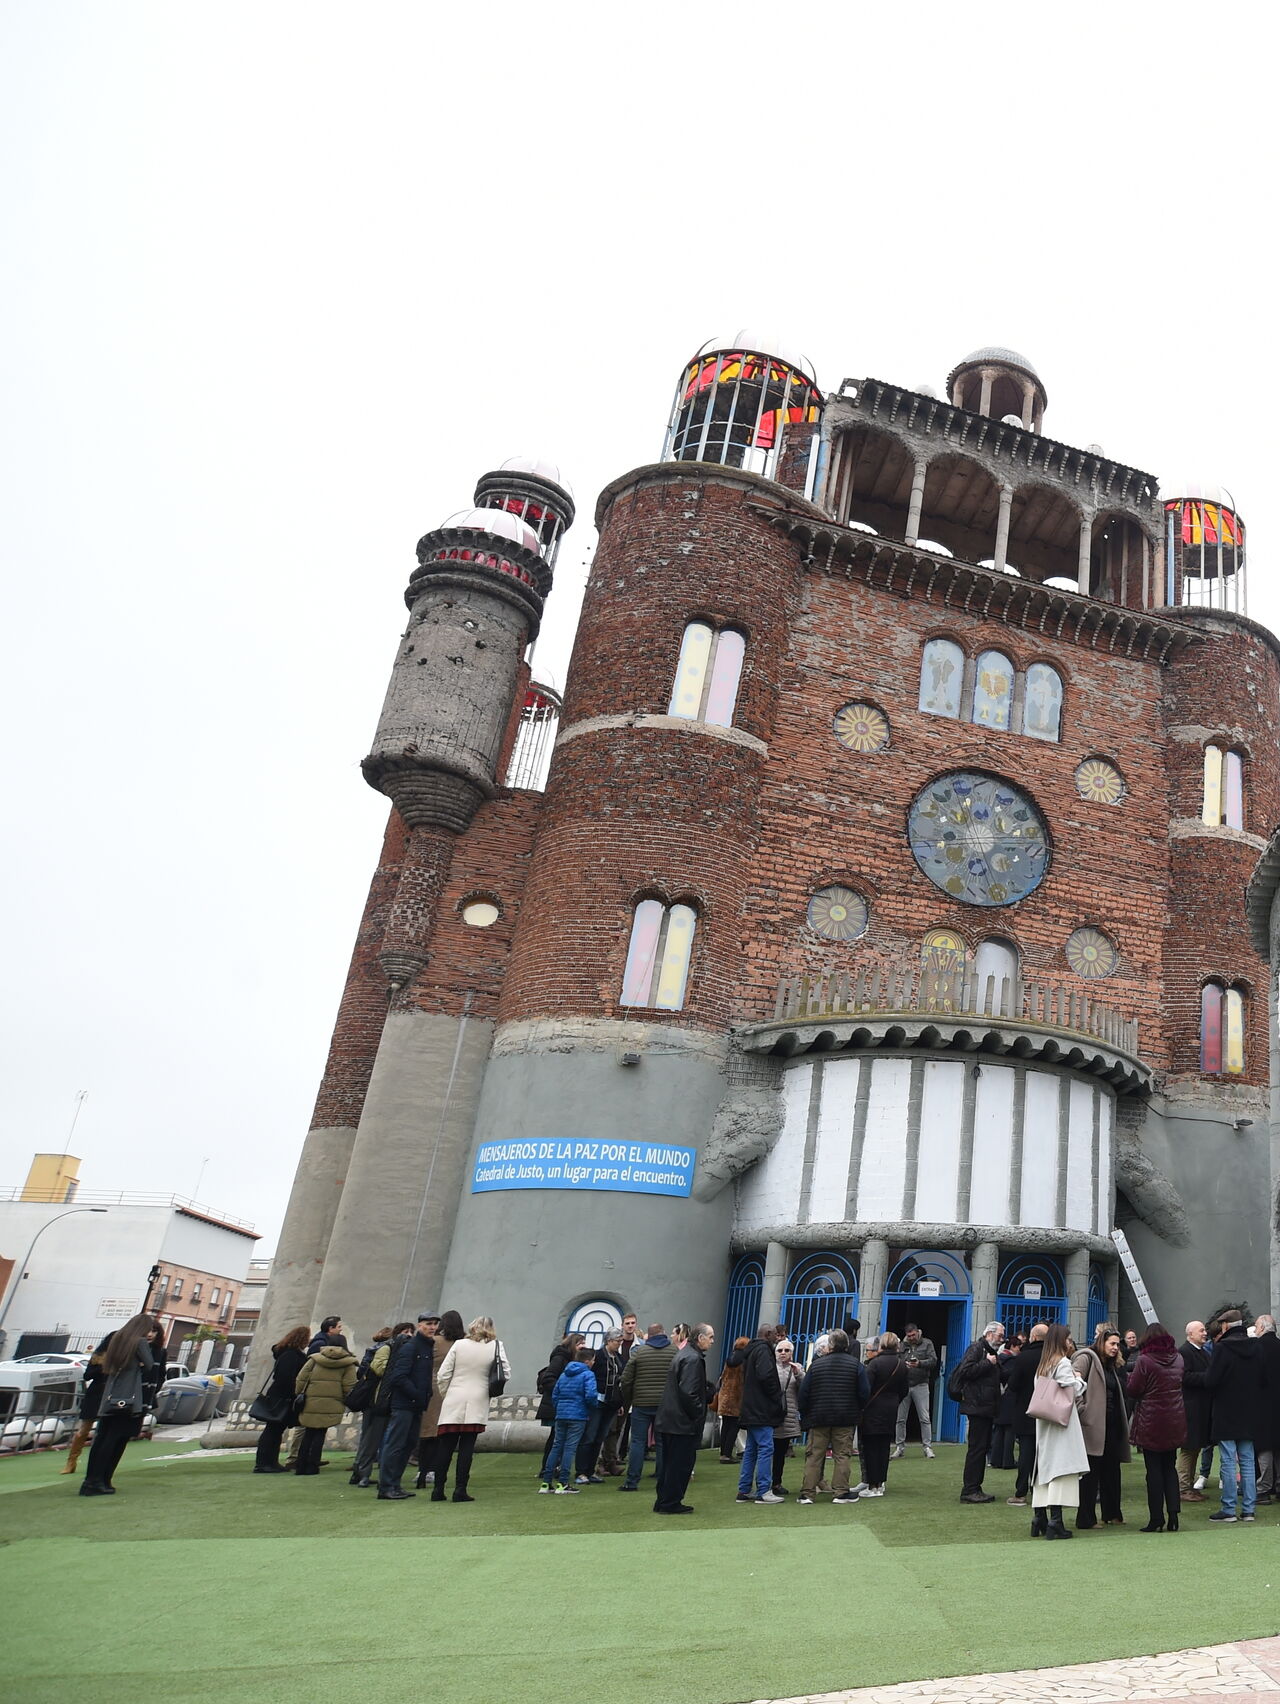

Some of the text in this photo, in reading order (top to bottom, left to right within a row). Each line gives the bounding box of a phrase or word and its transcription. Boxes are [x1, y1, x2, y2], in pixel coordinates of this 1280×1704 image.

[479, 1143, 690, 1168] MENSAJEROS DE LA PAZ POR EL MUNDO
[475, 1162, 687, 1187] Catedral de Justo, un lugar para el encuentro.
